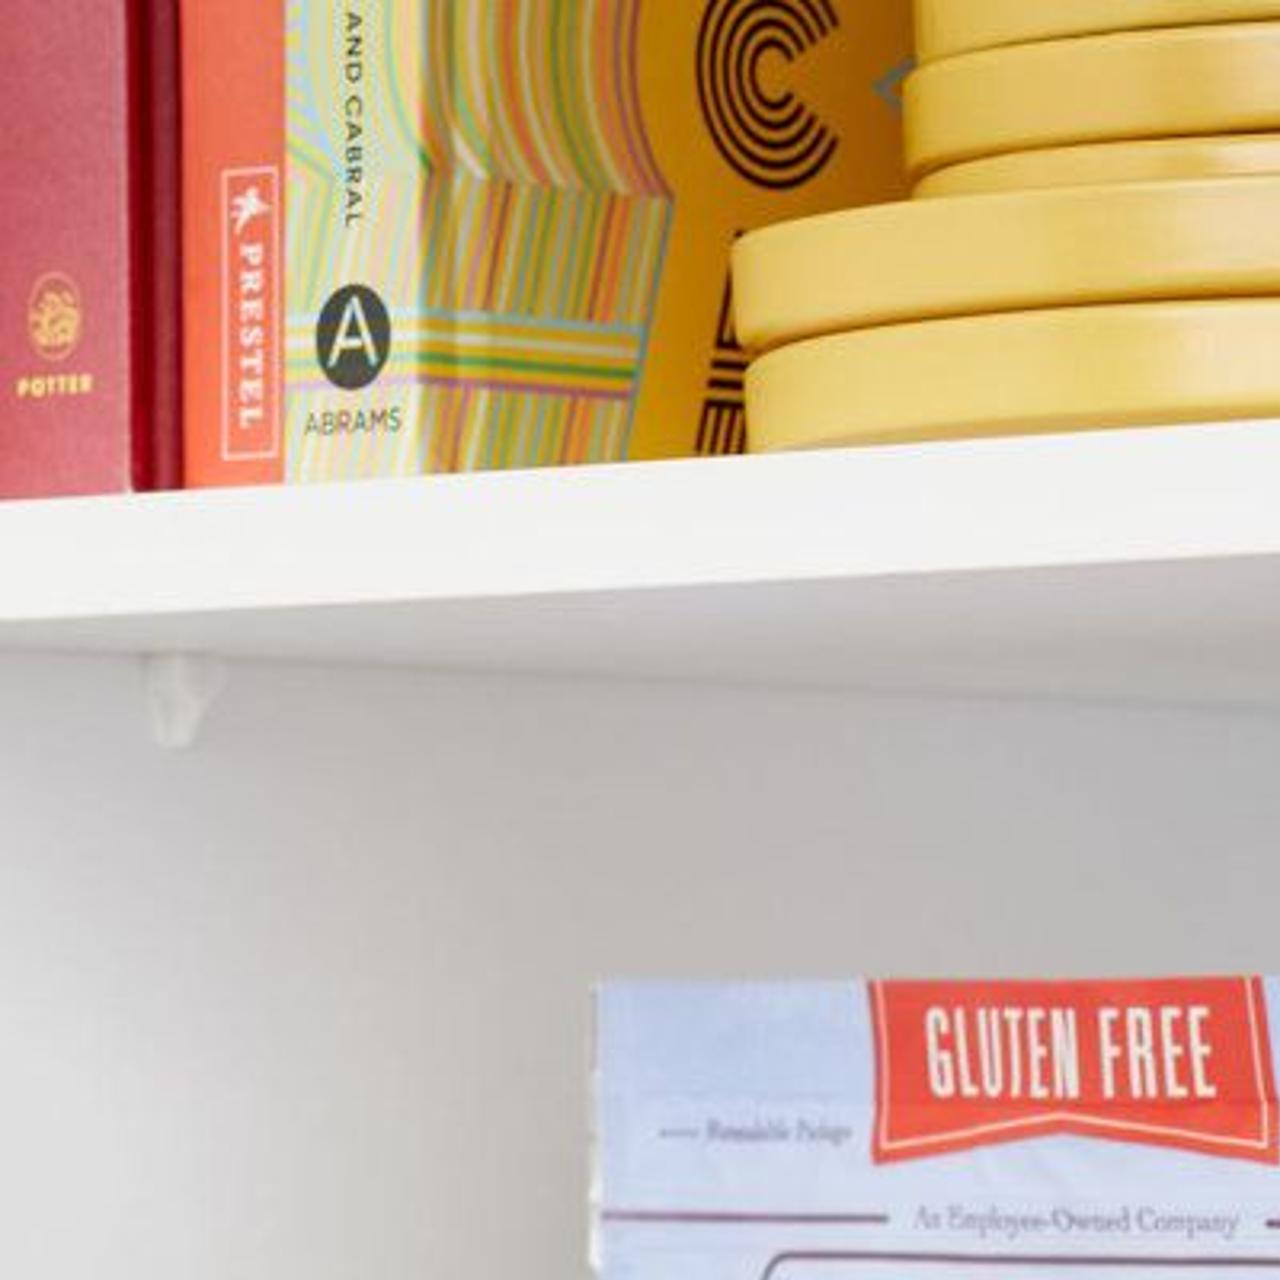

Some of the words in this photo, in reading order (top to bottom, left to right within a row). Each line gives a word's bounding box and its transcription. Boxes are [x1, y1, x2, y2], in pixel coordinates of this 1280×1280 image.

[346, 12, 363, 84] AND
[345, 95, 363, 228] CABRAL
[239, 242, 264, 430] PRESTEL
[327, 294, 379, 368] A
[16, 373, 94, 398] POTTER
[303, 406, 402, 436] ABRAMS
[925, 1006, 1081, 1100] GLUTEN
[1099, 1005, 1217, 1099] FREE
[913, 1206, 941, 1231] An
[948, 1206, 1130, 1240] Employee-Owned
[1138, 1207, 1239, 1240] Company
